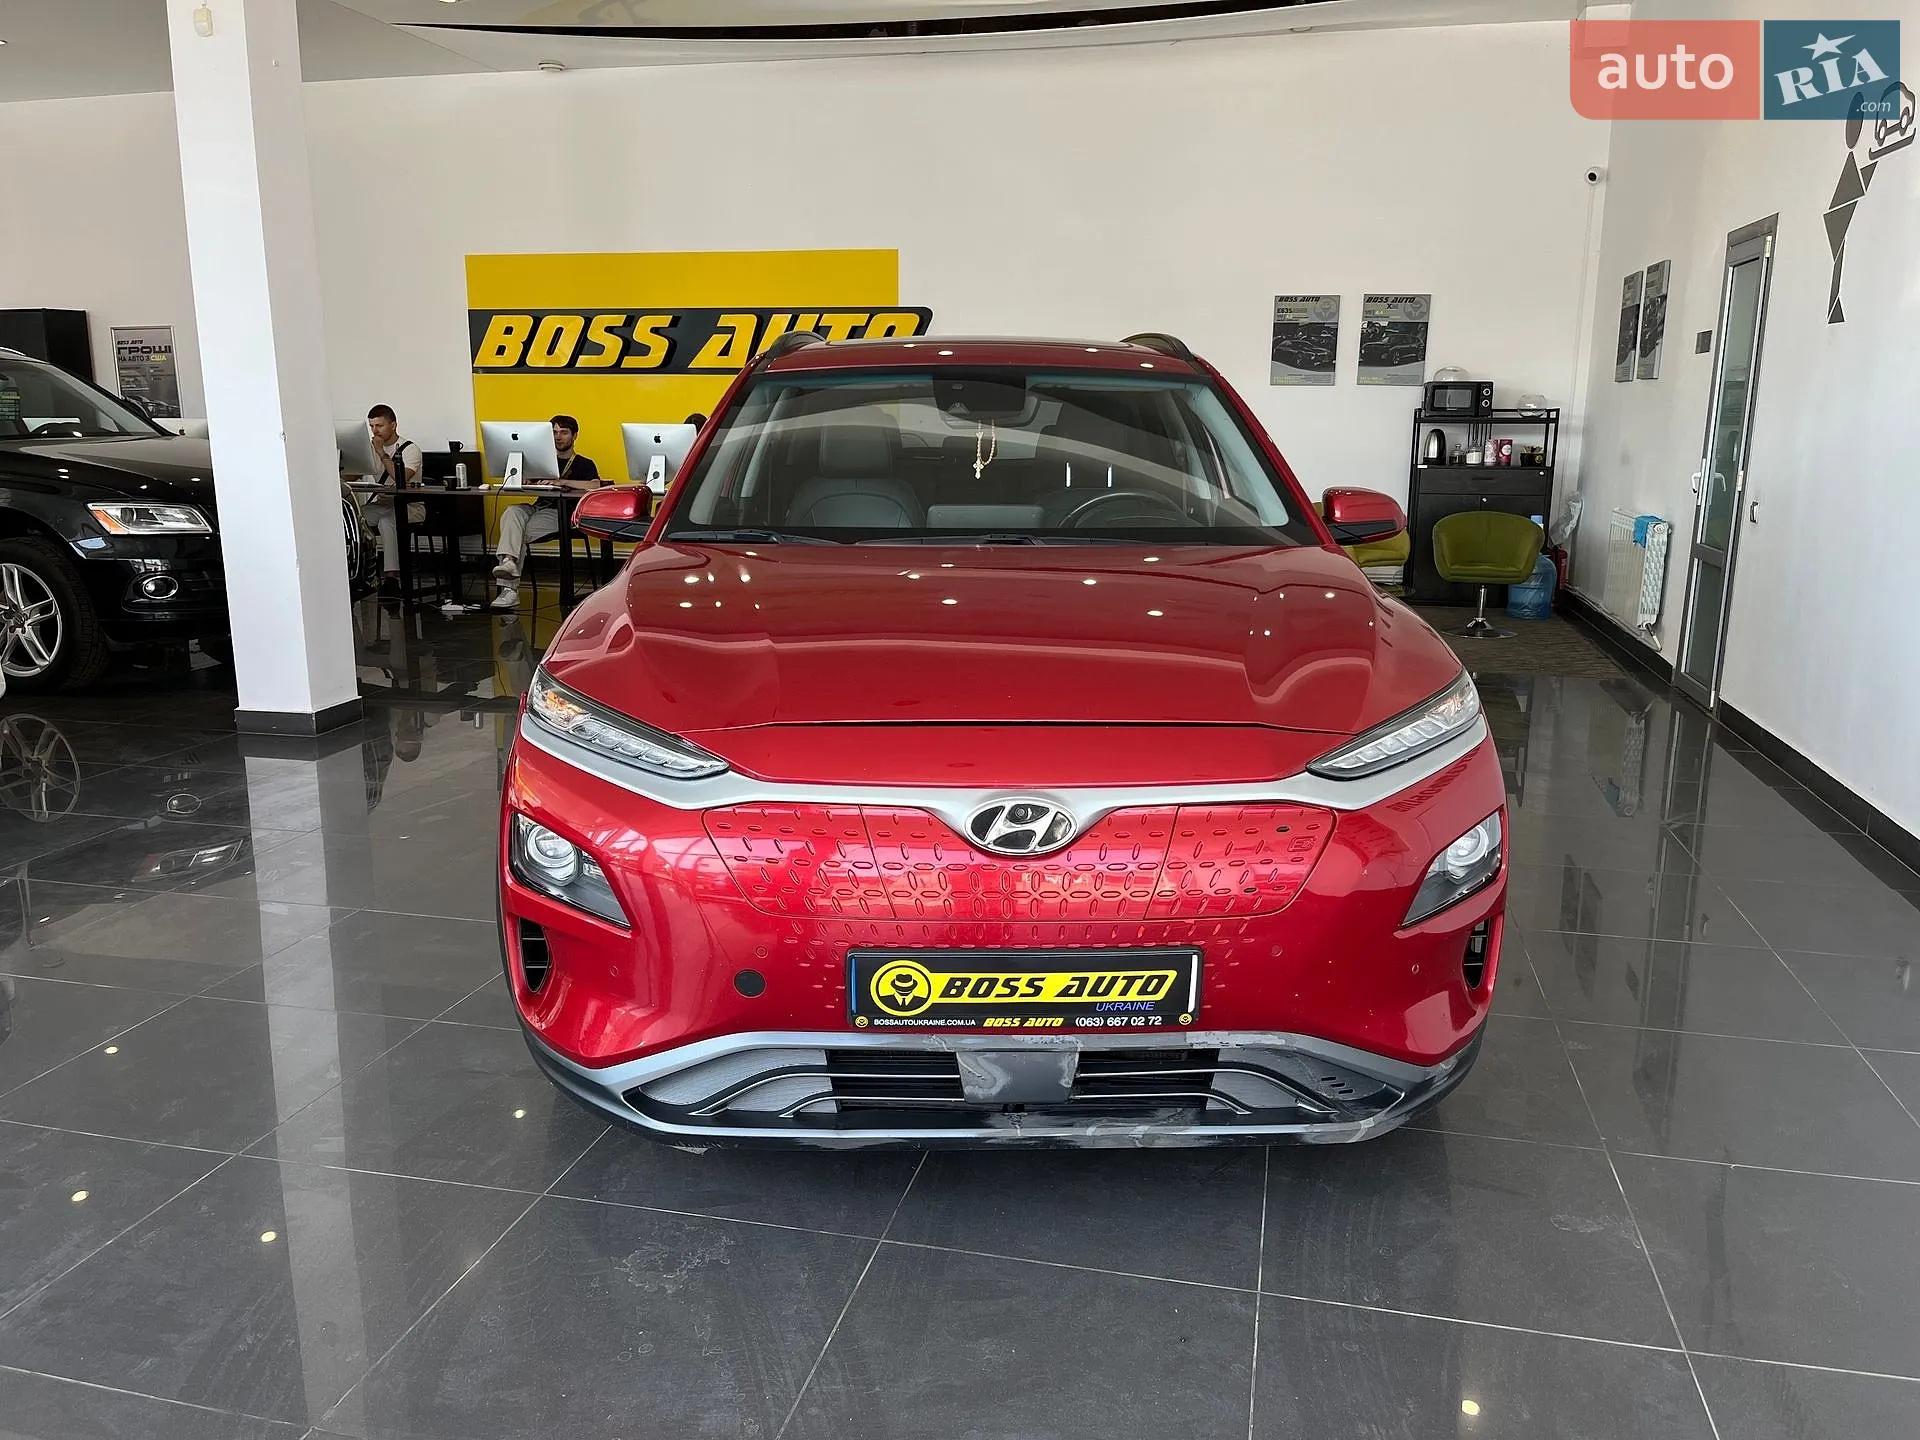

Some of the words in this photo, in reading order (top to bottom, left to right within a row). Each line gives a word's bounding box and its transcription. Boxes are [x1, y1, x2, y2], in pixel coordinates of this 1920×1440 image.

[472, 313, 675, 369] BOSS
[117, 346, 172, 355] ГРОШІ
[938, 975, 1046, 999] BOSS
[1053, 973, 1171, 998] AUTO
[1095, 1001, 1156, 1013] UKRAINE
[873, 1018, 977, 1027] BOSSAUTOUKRAINE.COM.UA
[982, 1017, 1021, 1028] BOSS
[1023, 1017, 1065, 1028] AUTO
[1075, 1016, 1104, 1028] (063)
[1106, 1016, 1130, 1027] 667
[1130, 1016, 1146, 1027] 02
[1147, 1015, 1163, 1026] 72
